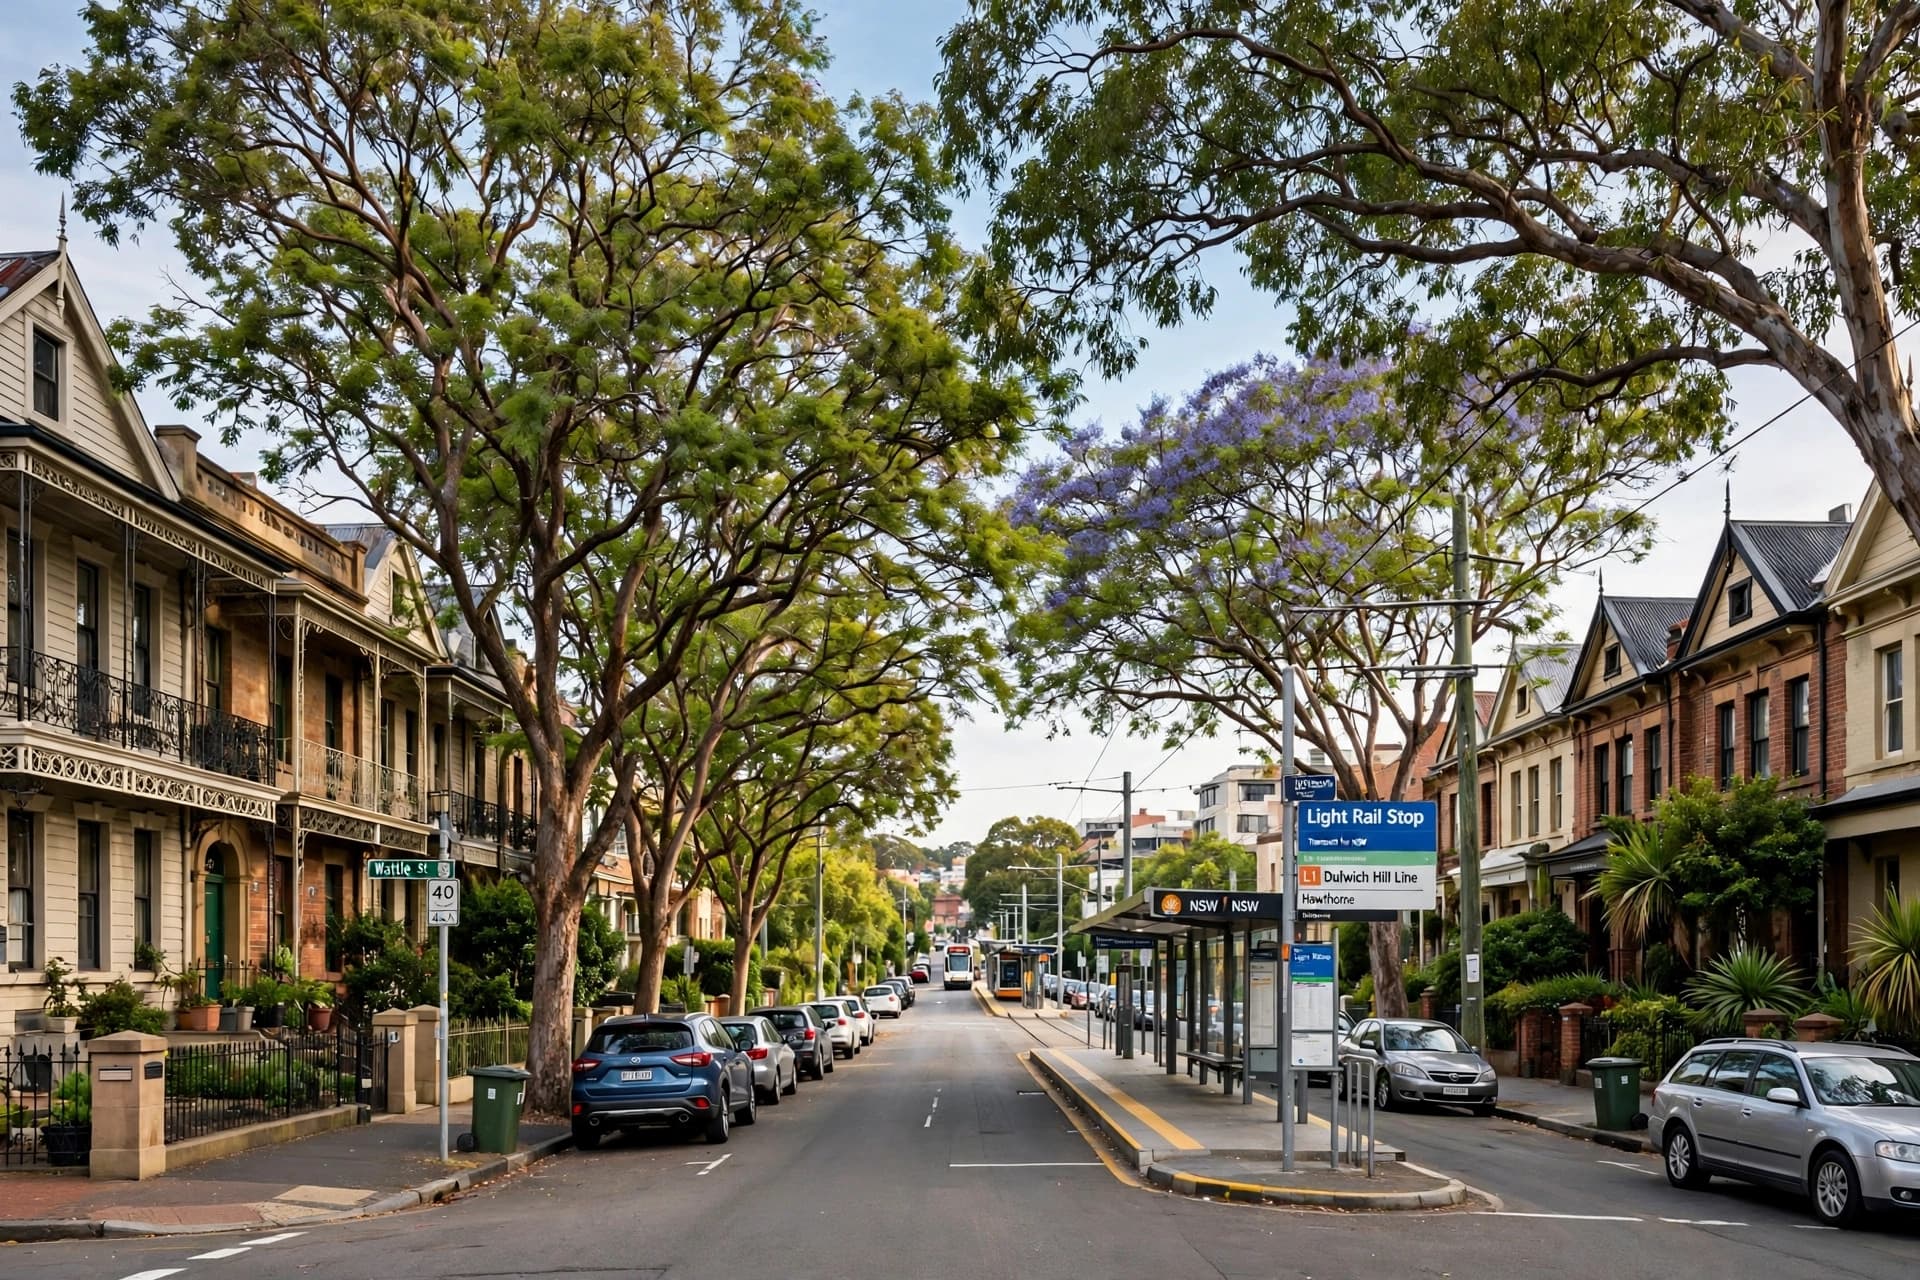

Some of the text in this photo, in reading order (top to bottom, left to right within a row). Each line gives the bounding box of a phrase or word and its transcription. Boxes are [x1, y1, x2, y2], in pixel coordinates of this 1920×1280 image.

[1307, 808, 1425, 828] Light Rail Stop
[374, 862, 428, 876] Wattle St
[1303, 870, 1418, 883] L1 Dulwich Hill Line
[432, 885, 454, 900] 40
[1302, 892, 1355, 905] Hawthorne
[1190, 900, 1260, 912] NSW NSW
